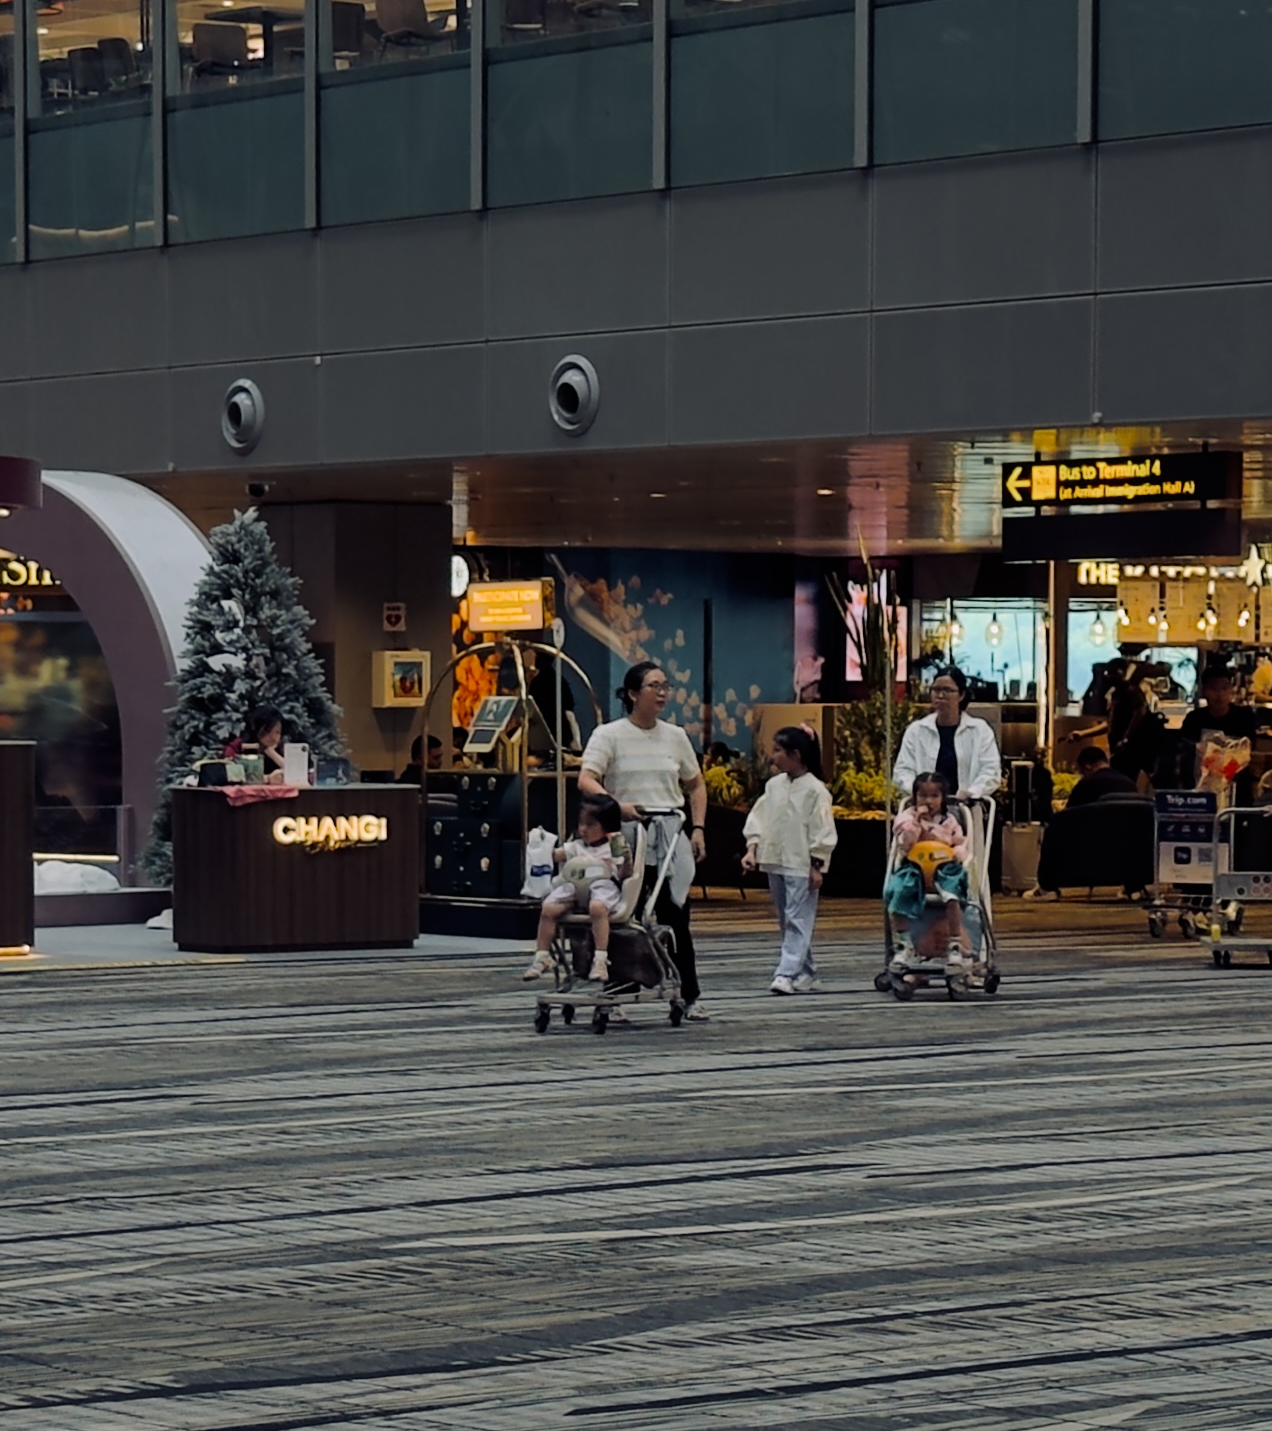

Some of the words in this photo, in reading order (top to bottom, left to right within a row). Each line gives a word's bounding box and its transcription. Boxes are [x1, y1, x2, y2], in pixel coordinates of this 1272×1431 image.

[1059, 465, 1081, 480] Bus
[1082, 465, 1096, 480] to
[1096, 460, 1150, 480] Terminal
[1152, 459, 1161, 475] 4
[1166, 794, 1207, 806] Trip.com
[273, 815, 388, 845] CHANGI
